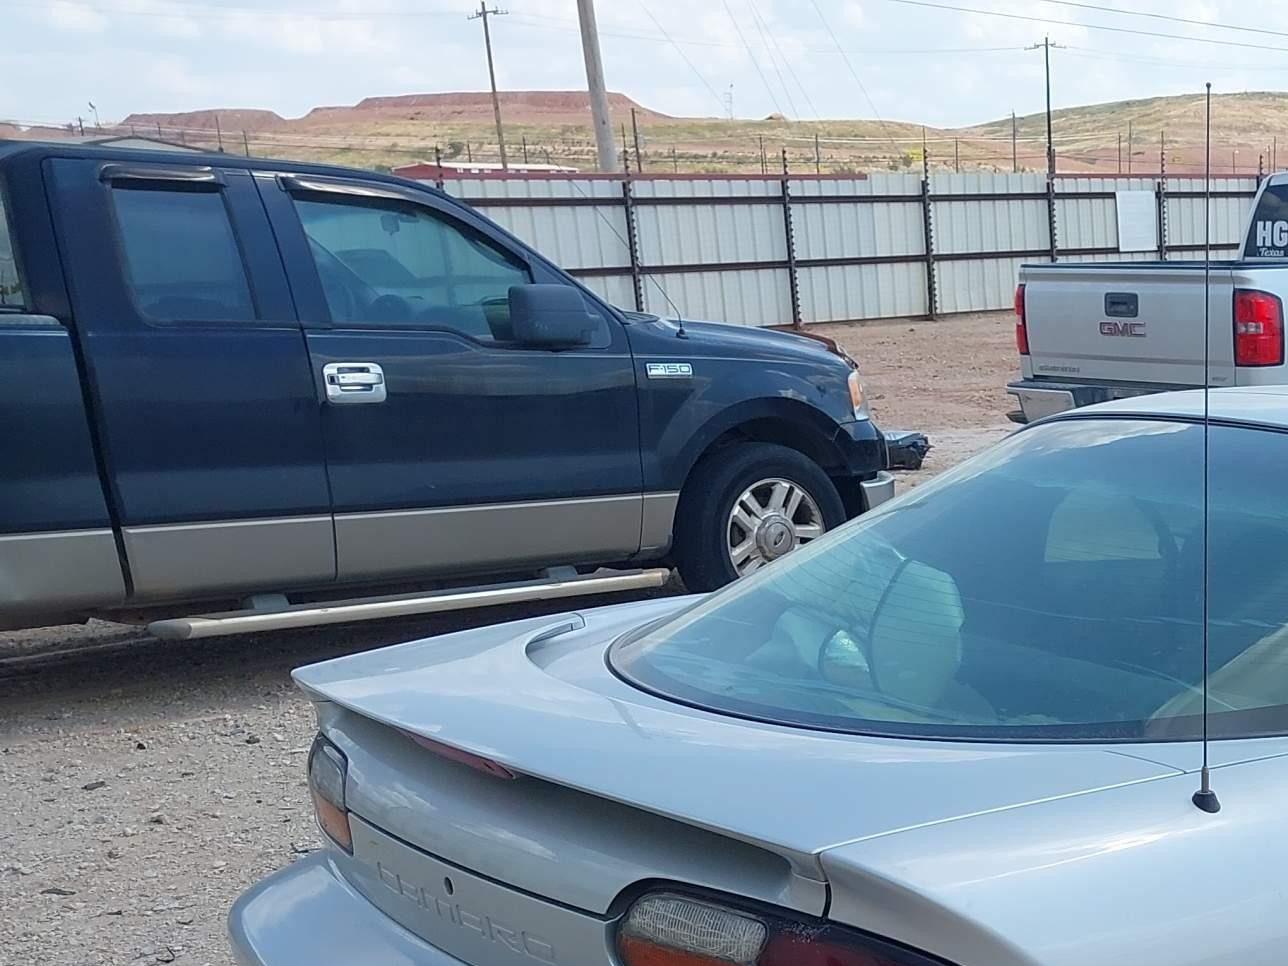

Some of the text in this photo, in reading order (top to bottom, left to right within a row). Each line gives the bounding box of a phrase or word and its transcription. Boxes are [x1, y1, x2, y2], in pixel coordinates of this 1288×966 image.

[1256, 220, 1288, 248] HG
[1099, 321, 1147, 338] GMC
[648, 364, 691, 374] F-150
